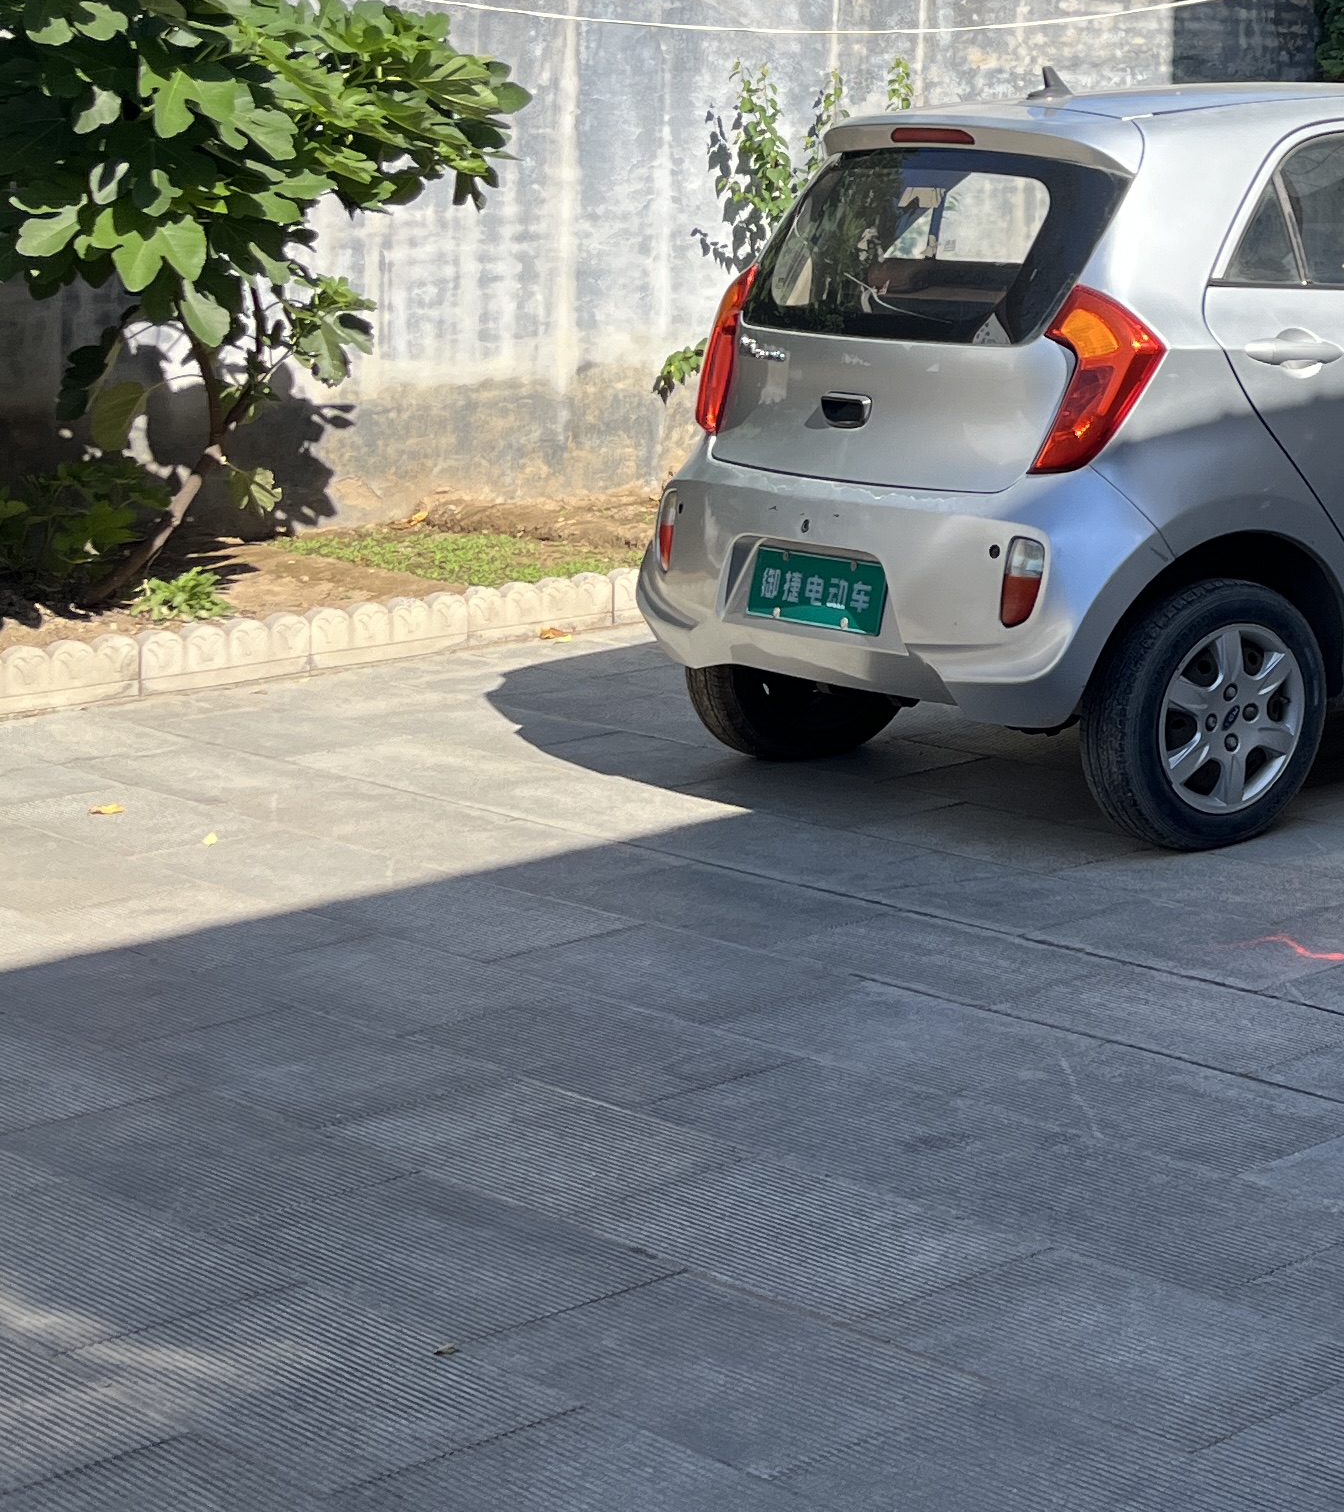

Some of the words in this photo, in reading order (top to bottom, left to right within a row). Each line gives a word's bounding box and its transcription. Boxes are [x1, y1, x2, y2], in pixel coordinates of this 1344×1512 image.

[760, 567, 873, 614] 御捷电动车
